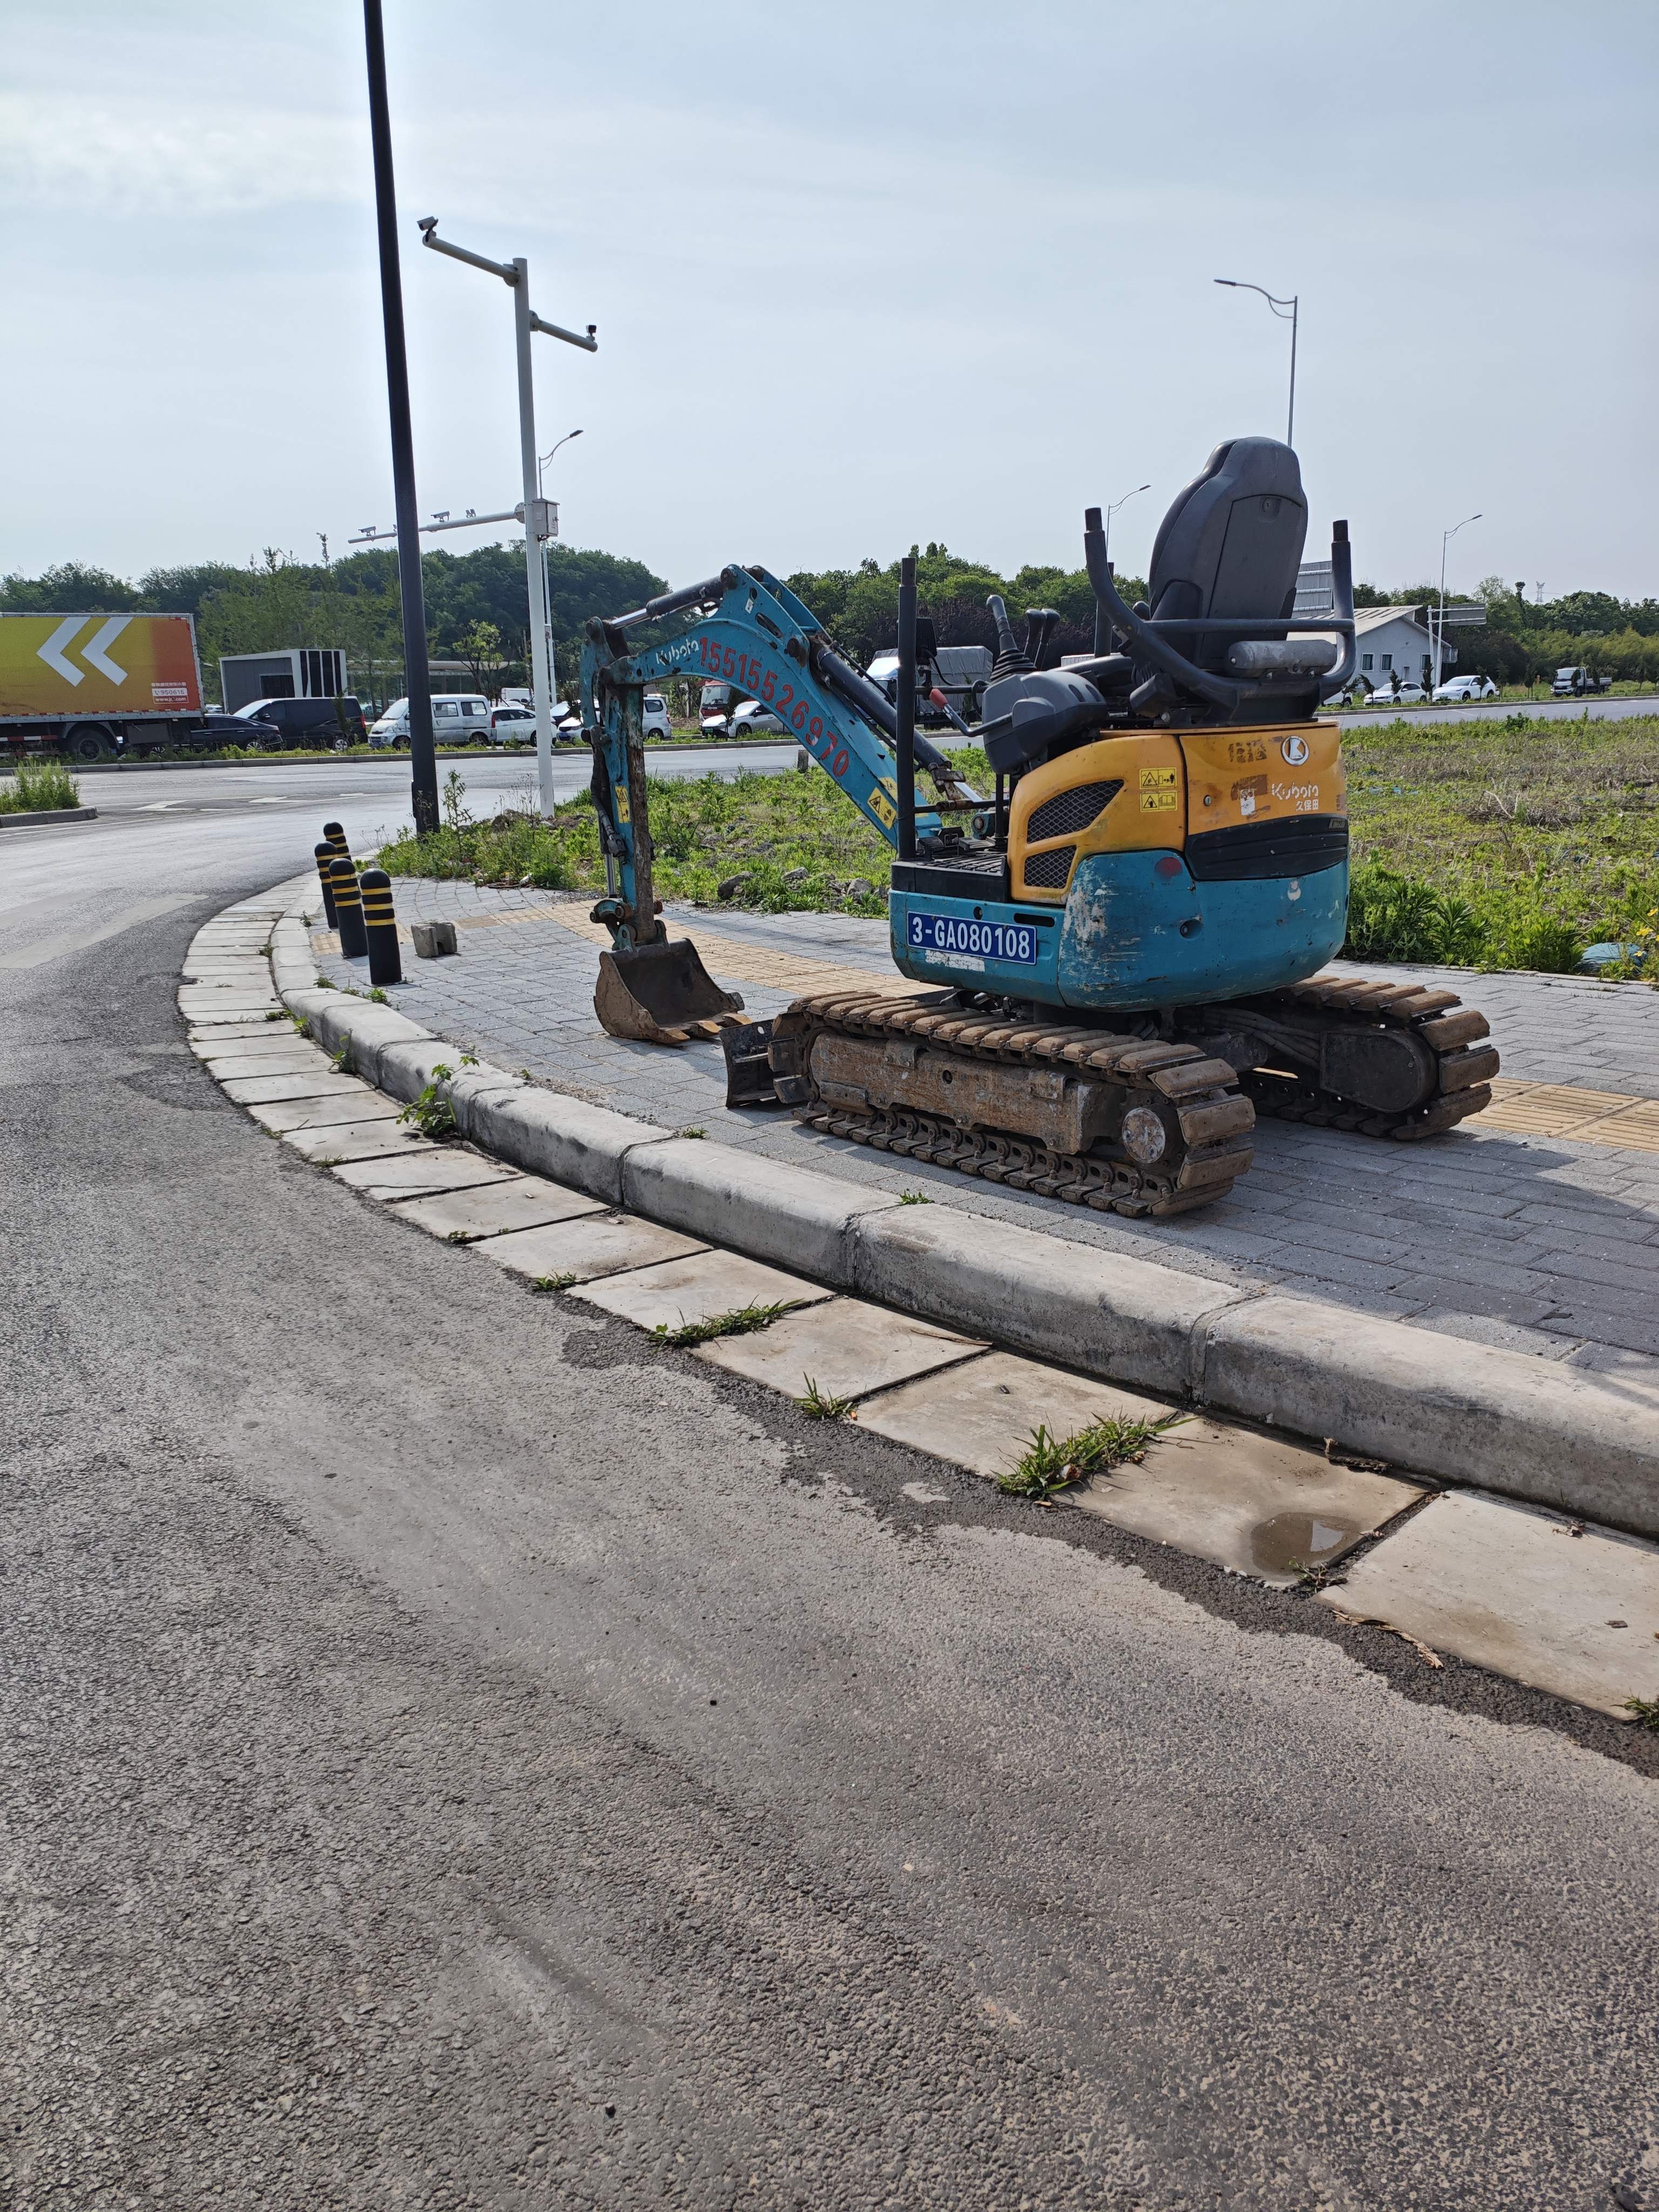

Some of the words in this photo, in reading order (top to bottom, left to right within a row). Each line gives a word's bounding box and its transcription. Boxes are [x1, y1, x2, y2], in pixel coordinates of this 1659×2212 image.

[656, 638, 699, 666] Kubota
[700, 637, 849, 778] 15515526970
[1296, 799, 1319, 811] 久保田
[912, 916, 1030, 959] 3-GA080108
